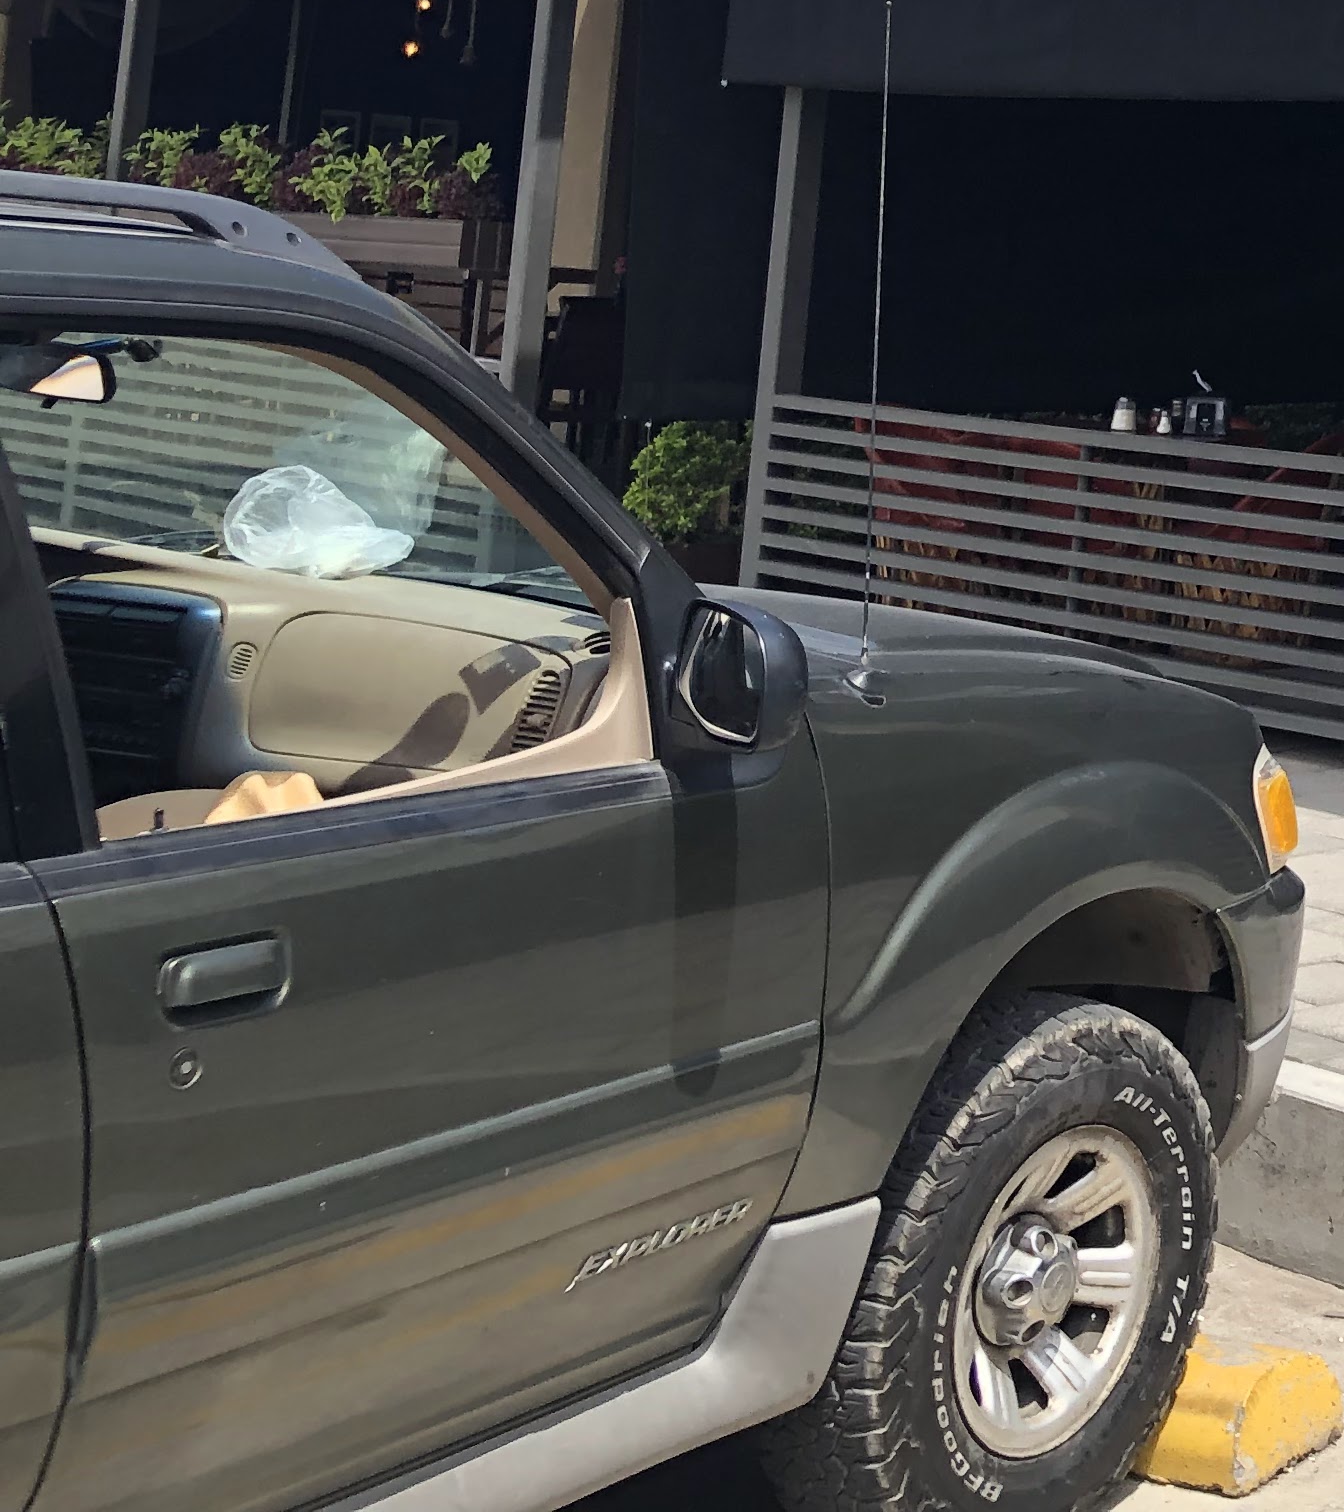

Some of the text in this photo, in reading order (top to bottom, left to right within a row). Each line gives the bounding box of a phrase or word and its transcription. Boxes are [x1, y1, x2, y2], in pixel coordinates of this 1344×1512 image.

[563, 1197, 754, 1294] EXPLORER
[1113, 1085, 1197, 1344] All-Terrain T/A
